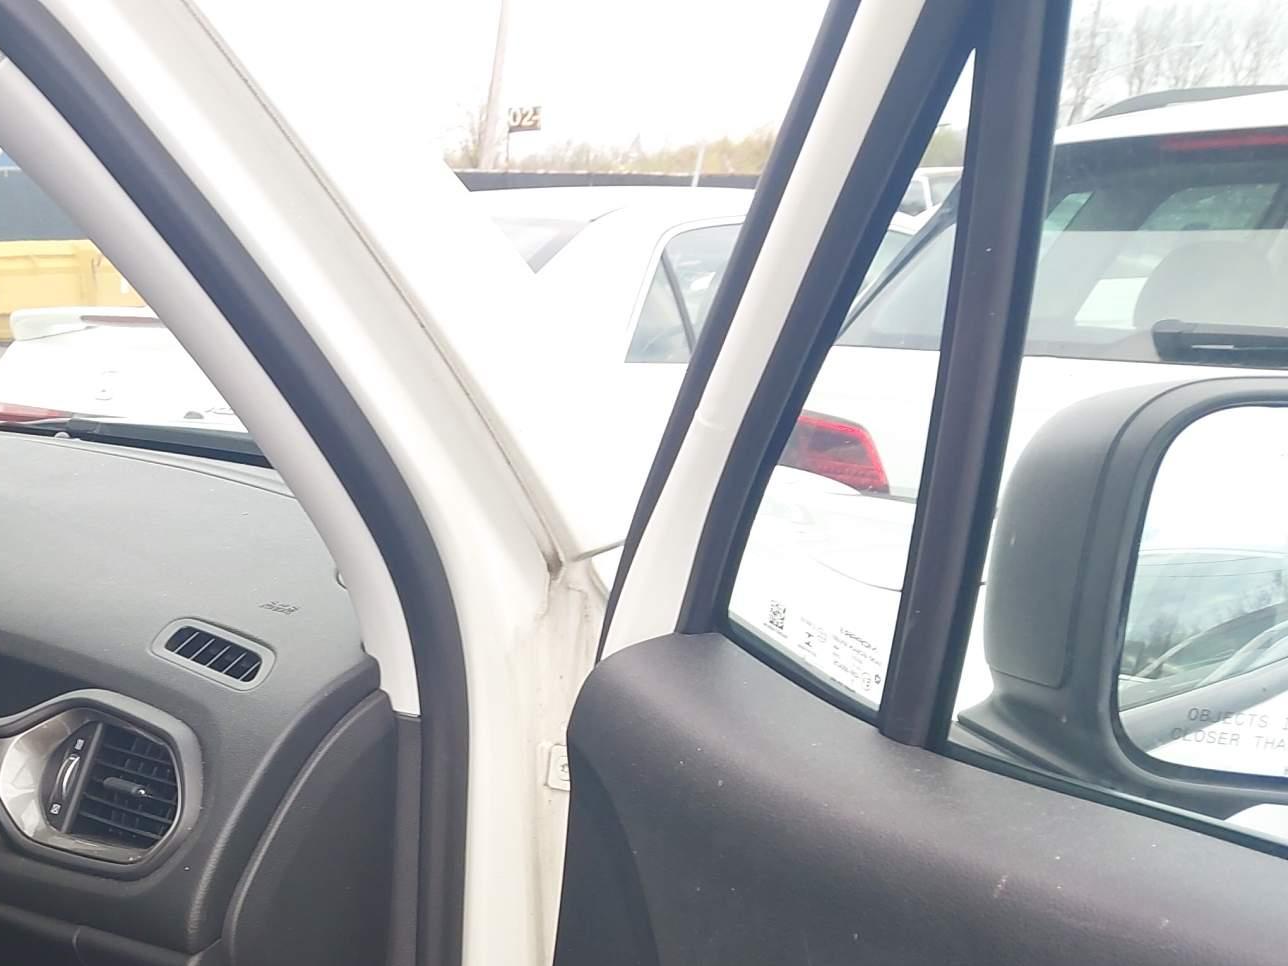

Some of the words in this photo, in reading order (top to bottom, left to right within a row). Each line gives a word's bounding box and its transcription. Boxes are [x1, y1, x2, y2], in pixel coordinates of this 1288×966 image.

[1187, 707, 1269, 729] OBJECTS
[1171, 727, 1240, 747] CLOSER
[1254, 734, 1288, 751] THA
